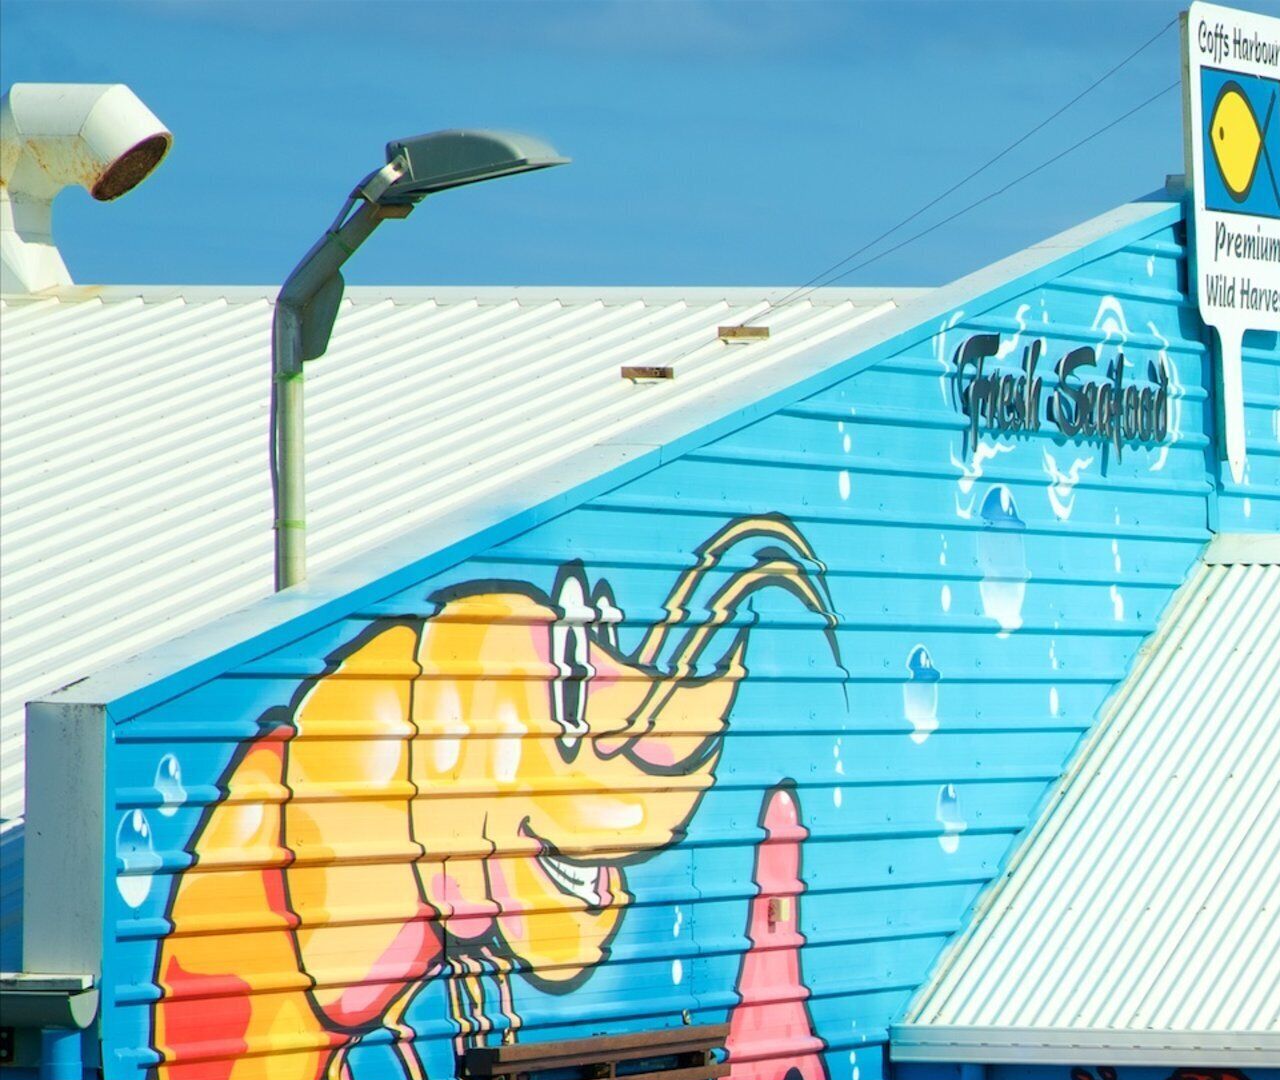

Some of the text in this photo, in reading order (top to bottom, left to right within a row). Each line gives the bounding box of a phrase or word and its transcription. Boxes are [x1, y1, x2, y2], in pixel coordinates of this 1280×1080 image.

[1198, 20, 1280, 67] Coffs Harbour
[1214, 220, 1280, 263] Premium
[1206, 273, 1235, 309] Wild
[957, 332, 1169, 466] Fresh Seafood
